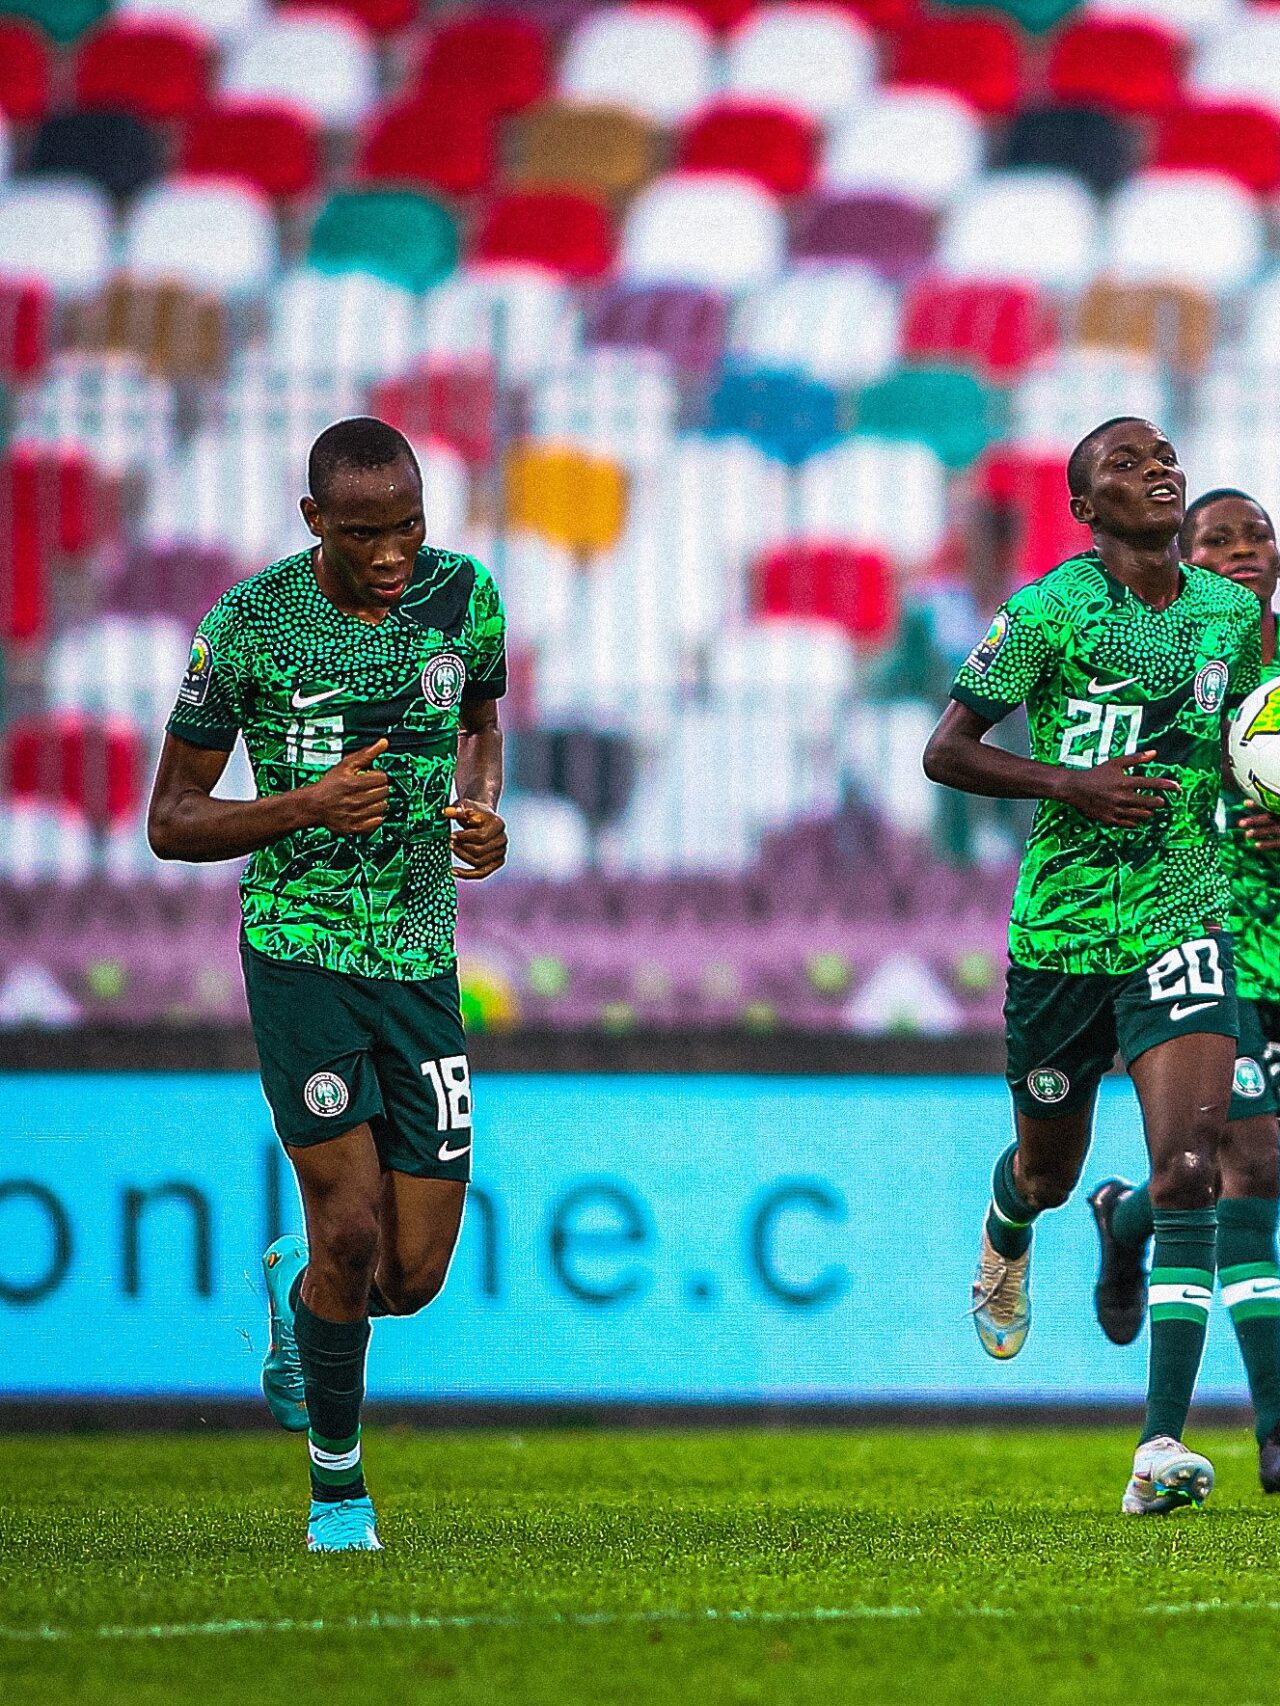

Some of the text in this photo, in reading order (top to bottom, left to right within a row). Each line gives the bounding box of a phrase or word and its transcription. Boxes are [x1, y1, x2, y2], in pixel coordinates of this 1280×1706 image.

[282, 715, 344, 766] 18
[1059, 698, 1144, 769] 20
[1147, 938, 1225, 1001] 20
[420, 1054, 472, 1132] 18
[0, 1142, 852, 1309] onle.c
